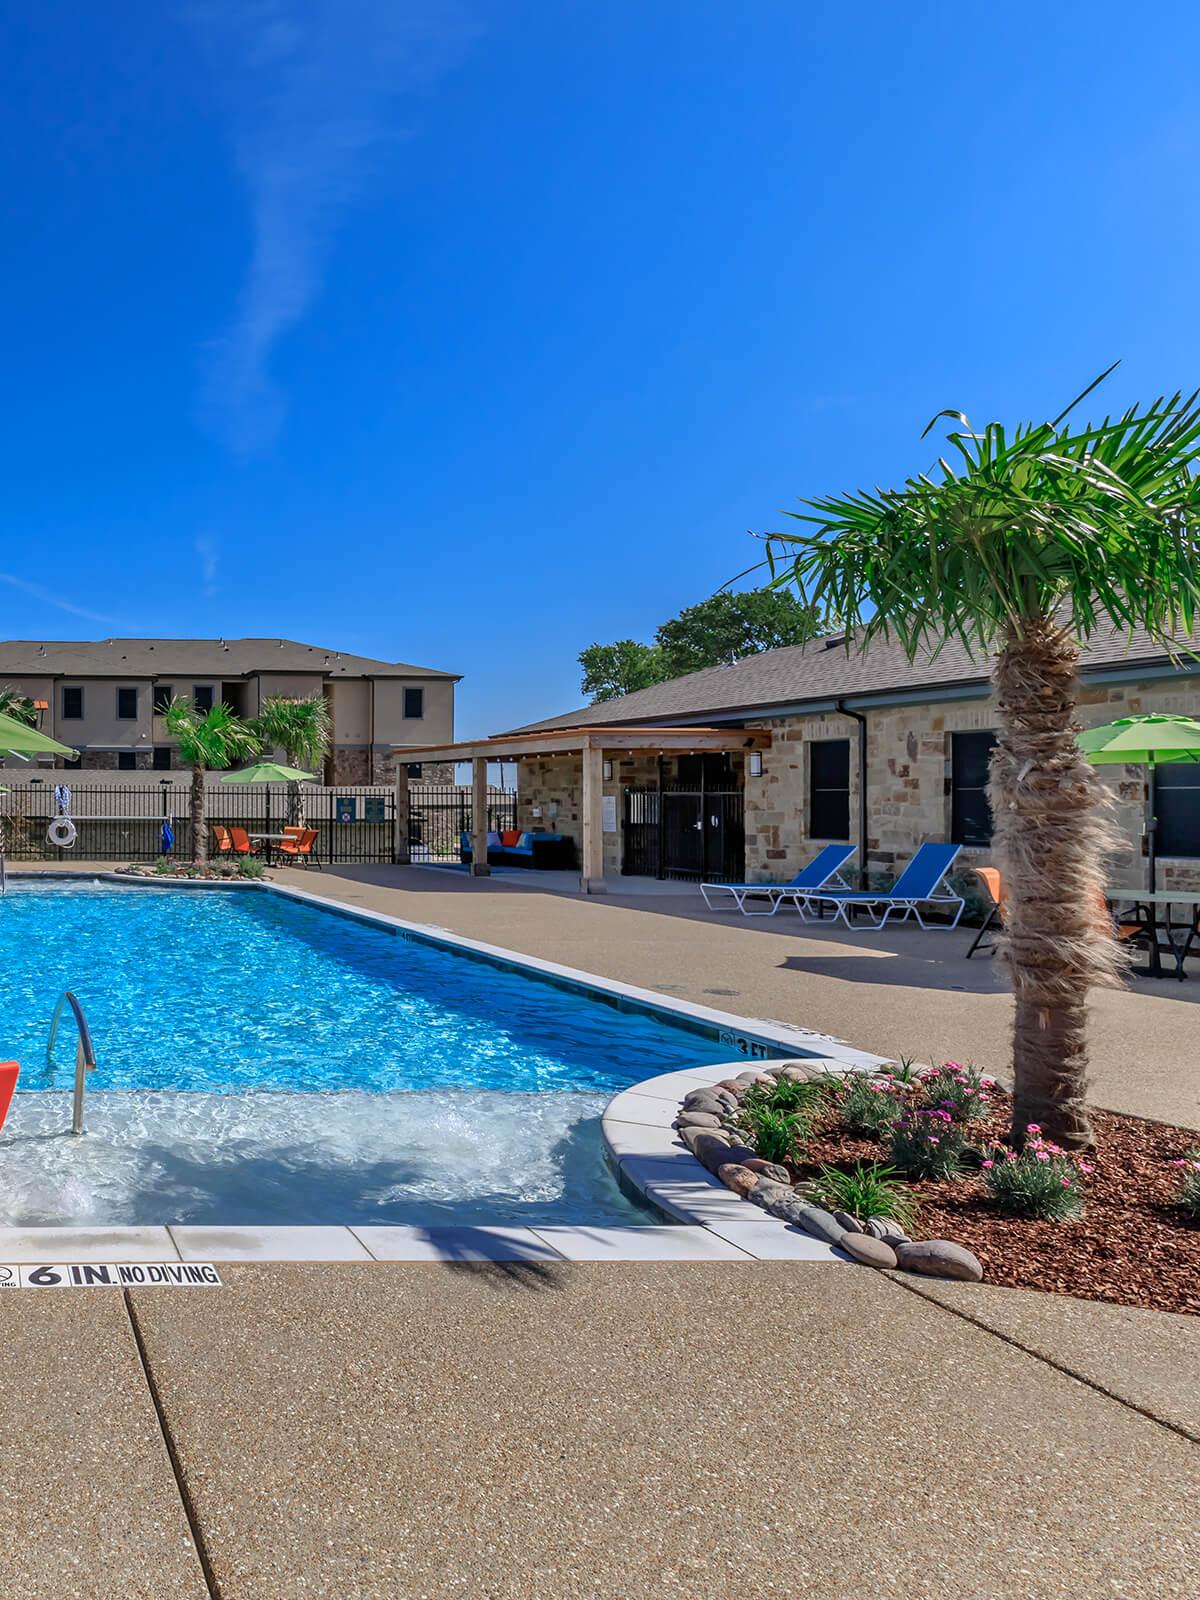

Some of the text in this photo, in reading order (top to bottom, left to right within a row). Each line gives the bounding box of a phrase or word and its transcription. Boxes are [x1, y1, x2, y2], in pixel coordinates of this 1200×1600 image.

[28, 1266, 219, 1286] 6 IN. NO DIVING
